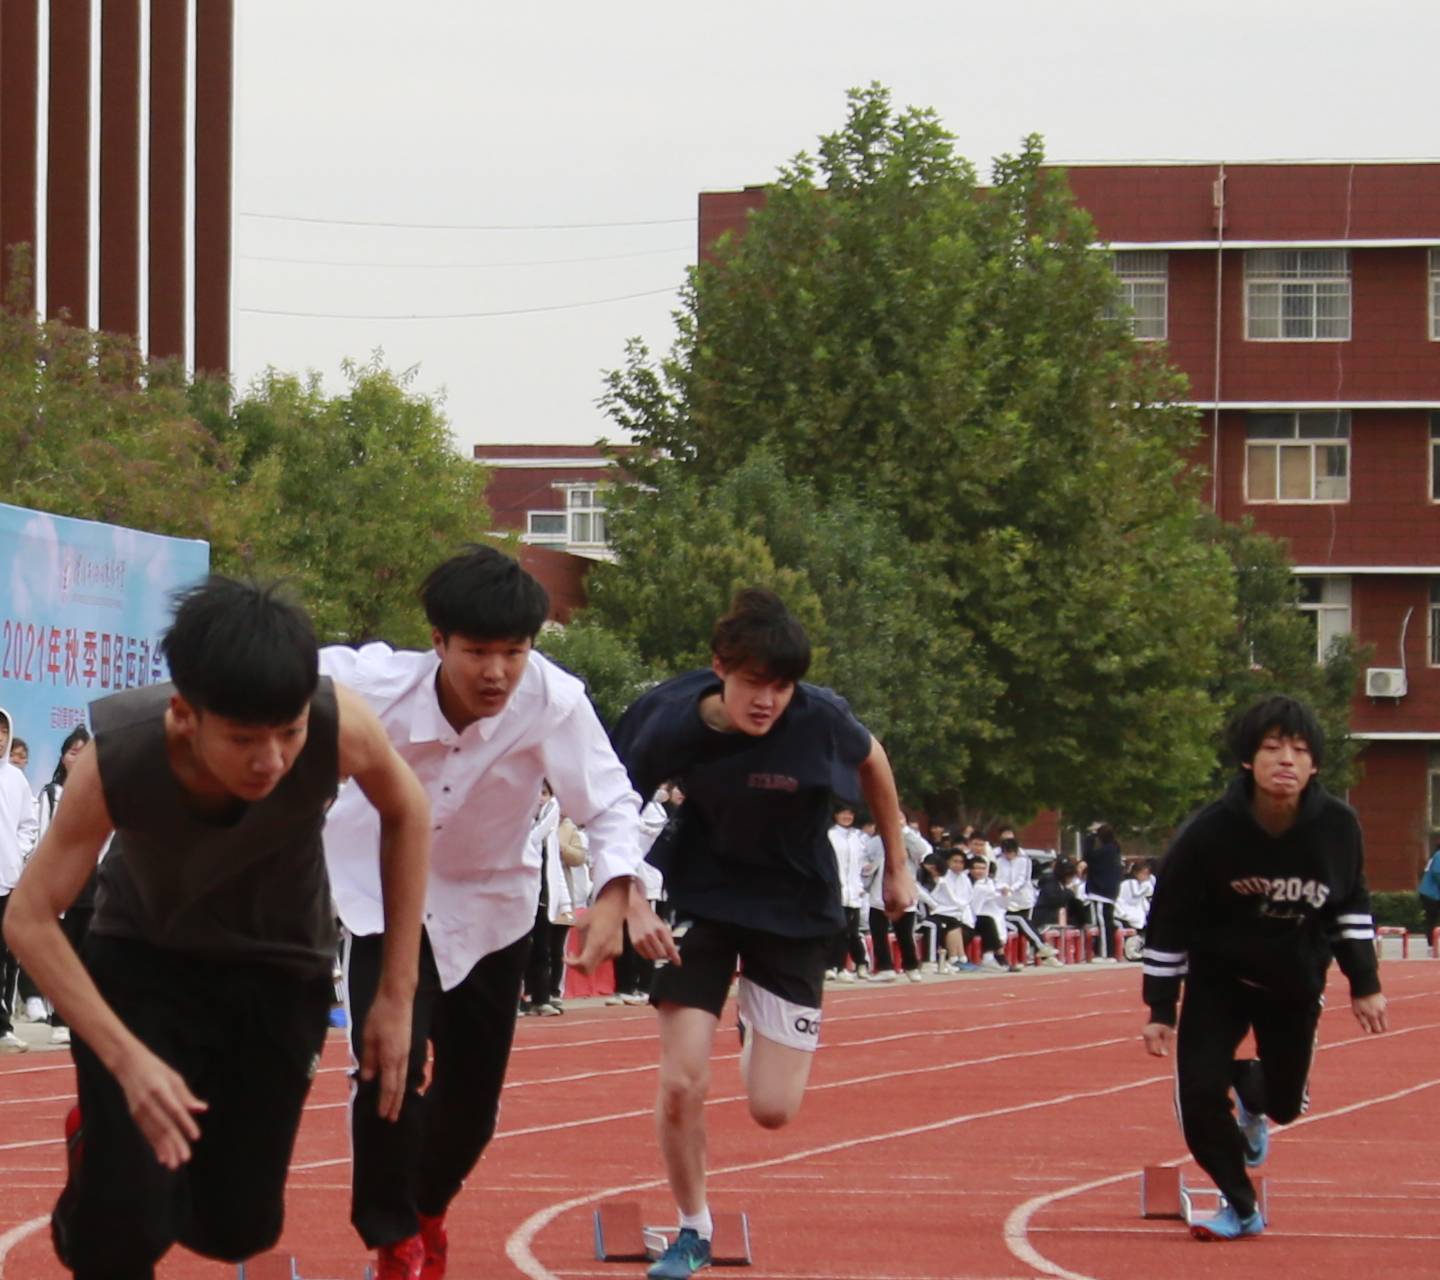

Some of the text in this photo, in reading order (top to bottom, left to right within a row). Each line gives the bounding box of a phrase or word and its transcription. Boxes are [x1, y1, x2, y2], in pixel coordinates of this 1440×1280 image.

[2, 619, 162, 690] 2021年秋季田径运动会
